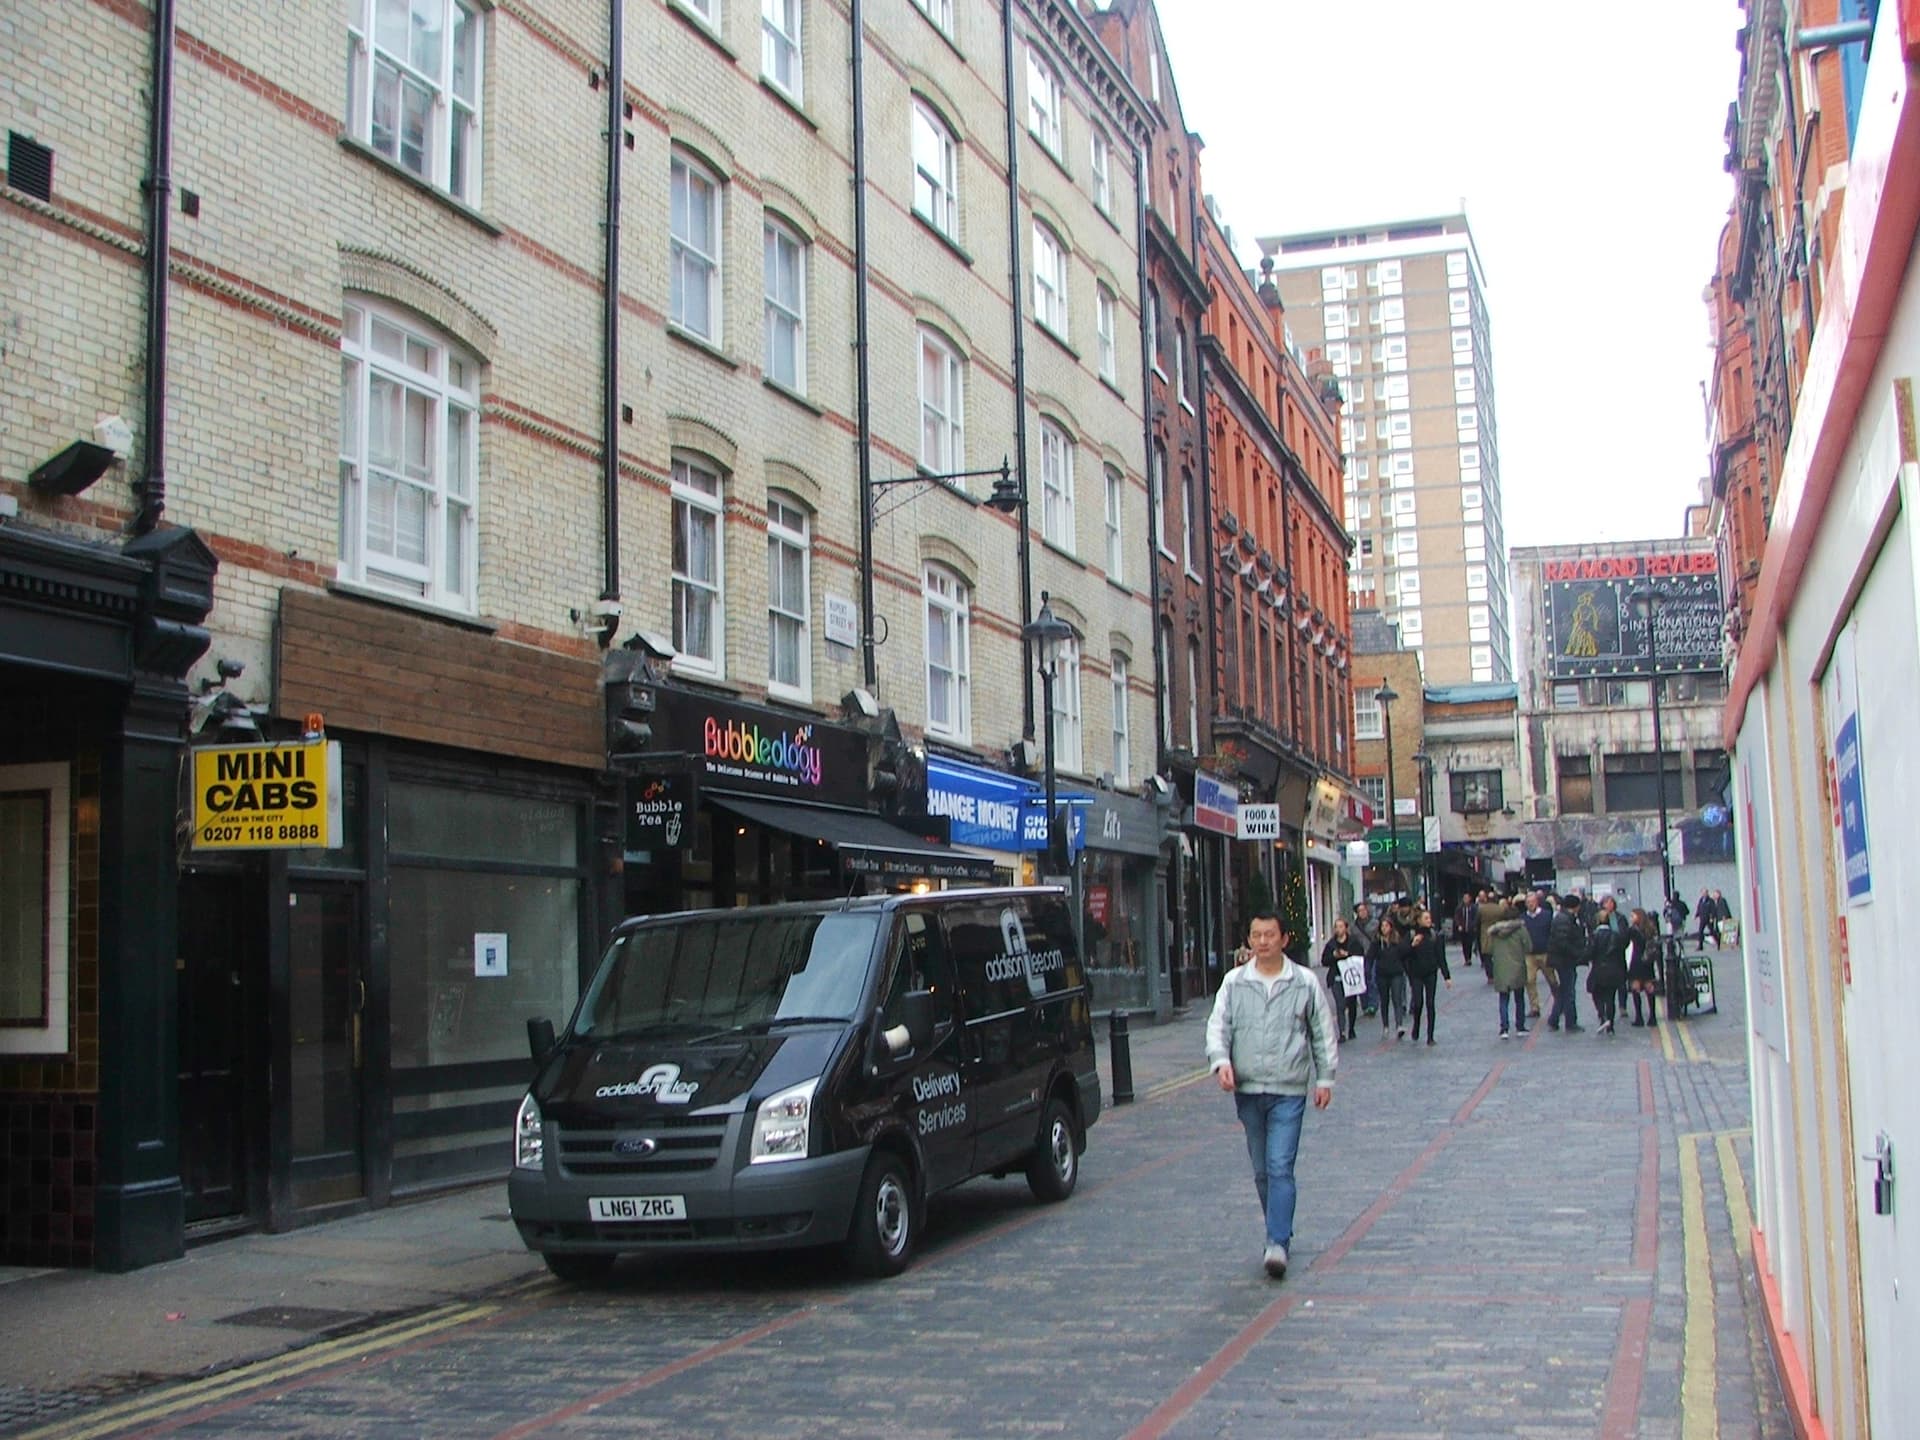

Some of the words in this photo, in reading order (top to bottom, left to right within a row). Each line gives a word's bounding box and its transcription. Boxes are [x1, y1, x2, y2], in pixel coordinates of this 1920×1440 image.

[1545, 558, 1638, 580] RAYMOND
[1645, 554, 1717, 575] REVUEB
[705, 716, 820, 785] Bubbleology
[217, 751, 305, 781] MINI
[206, 781, 318, 812] CABS
[636, 799, 682, 814] Bubble
[267, 815, 284, 823] CITY
[639, 814, 662, 826] Tea
[977, 799, 1019, 832] MONEY
[1244, 809, 1267, 820] FOOD
[1269, 809, 1276, 820] &
[204, 827, 242, 841] 0207
[249, 826, 273, 840] 118
[279, 824, 319, 839] 8888
[1246, 823, 1277, 834] WINE
[985, 952, 1026, 982] addison
[595, 1081, 660, 1098] addison
[672, 1080, 699, 1094] lee
[912, 1071, 960, 1102] Delivery
[918, 1102, 966, 1135] Services
[600, 1201, 637, 1217] LN61
[640, 1200, 674, 1216] ZRG
